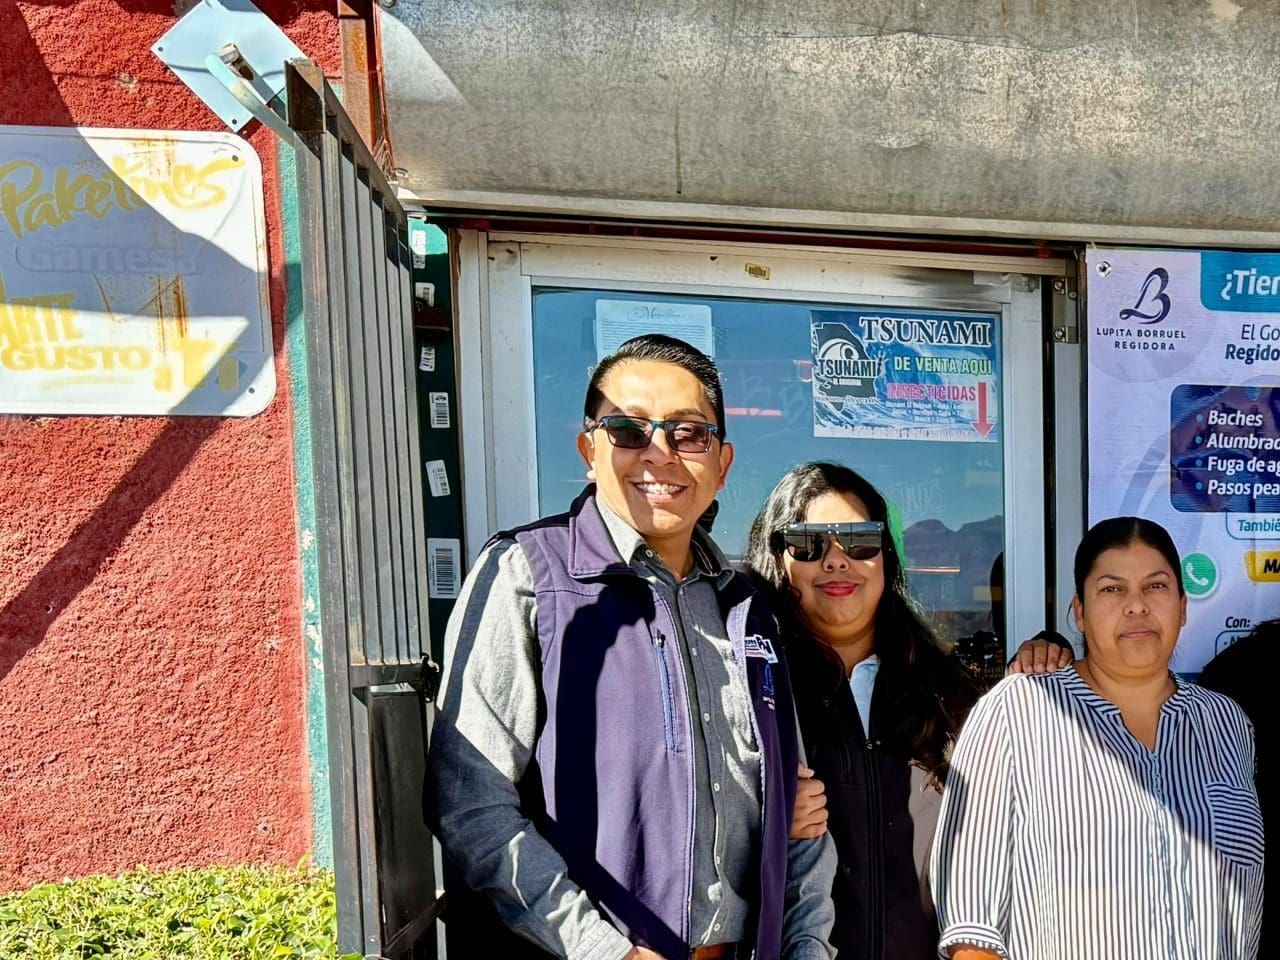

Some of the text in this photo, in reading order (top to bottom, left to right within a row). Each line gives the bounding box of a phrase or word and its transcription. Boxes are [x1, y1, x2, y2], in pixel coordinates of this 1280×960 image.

[859, 317, 992, 347] TSUNAMI
[1096, 327, 1187, 339] LUPITA BORRUEL
[1241, 324, 1255, 341] El
[1114, 340, 1176, 351] REGIDORA
[1, 345, 150, 372] GUSTO
[893, 356, 993, 375] DE VENTA AQUI
[818, 359, 877, 378] TSUNAMI
[886, 382, 977, 401] INSECTICIDAS
[1208, 410, 1263, 427] Baches
[1208, 456, 1244, 475] Fuga
[1247, 456, 1265, 472] de
[1208, 479, 1250, 495] Pasos
[1225, 616, 1250, 628] Con:
